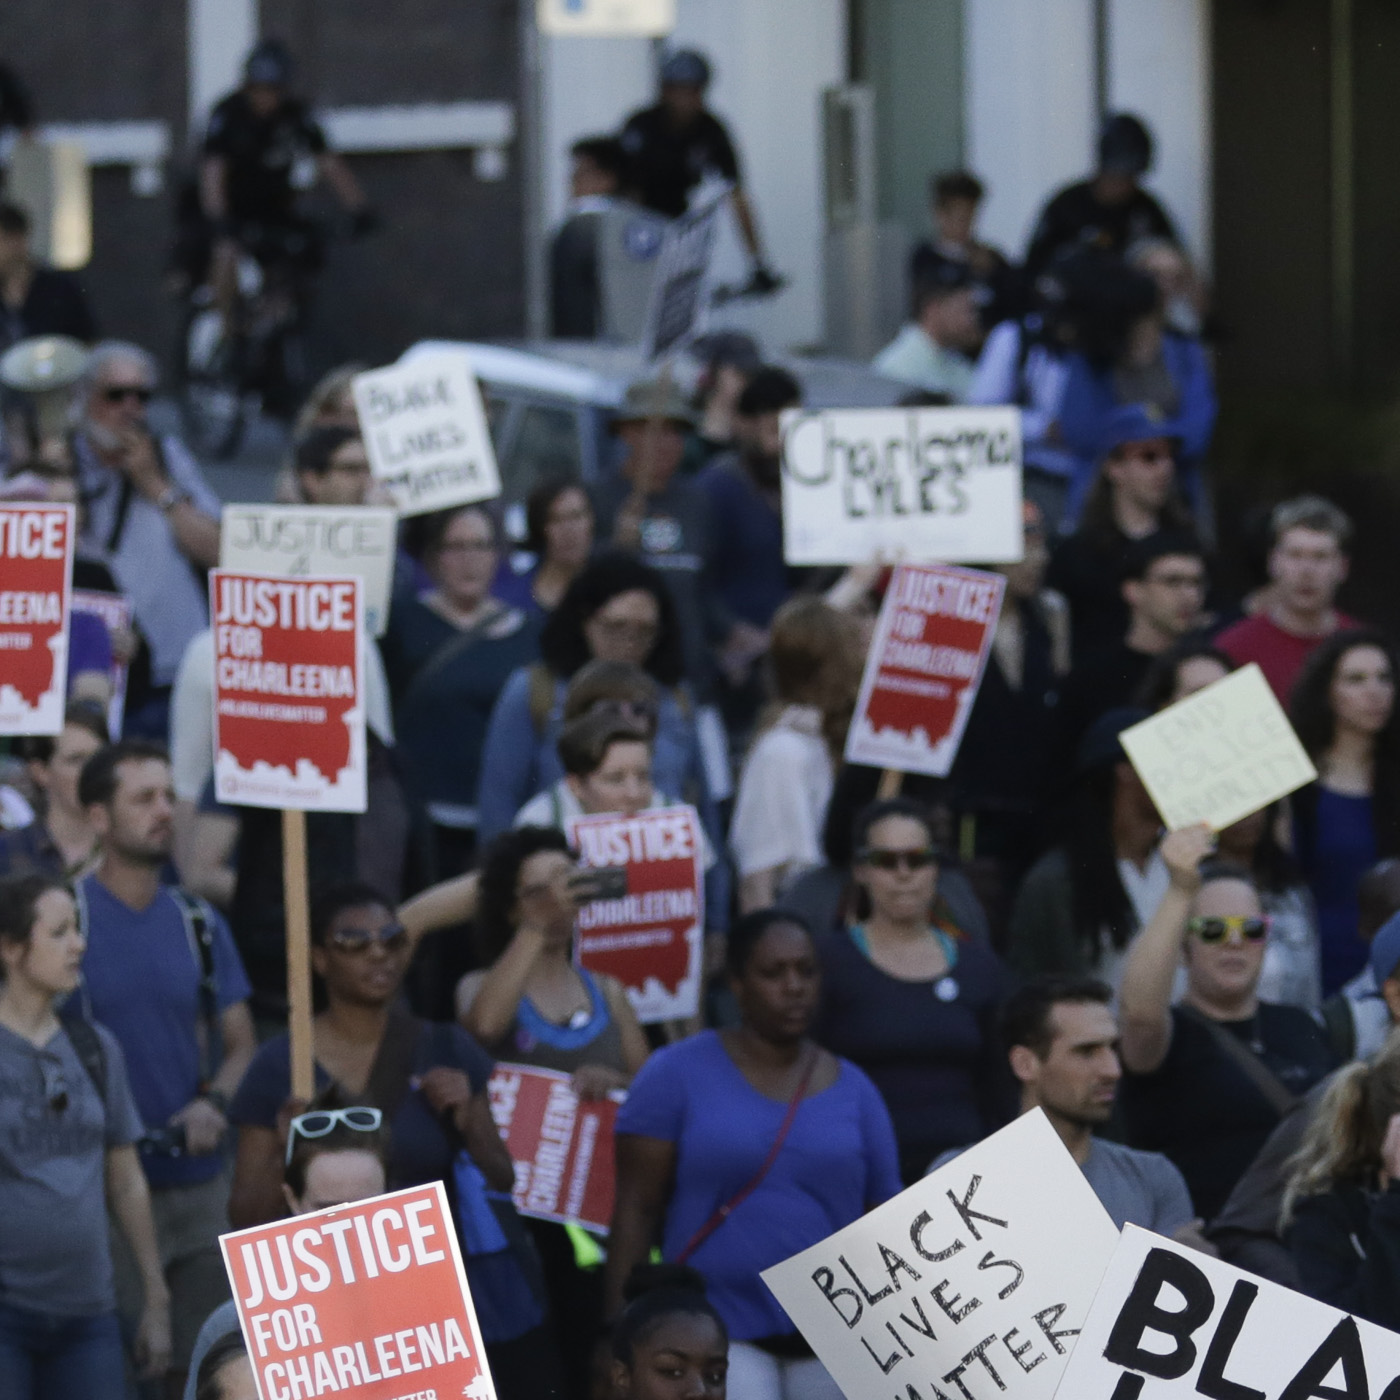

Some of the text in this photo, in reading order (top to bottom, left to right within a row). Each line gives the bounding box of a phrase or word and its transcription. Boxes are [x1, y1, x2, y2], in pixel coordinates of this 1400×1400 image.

[229, 512, 387, 558] JUSTICE
[217, 577, 355, 632] JUSTICE
[900, 566, 995, 623] JUSTICE
[217, 623, 263, 658] FOR
[218, 656, 357, 699] CHARLEENA
[578, 817, 693, 867] JUSTICE
[240, 1197, 446, 1309] JUSTICE
[811, 1173, 1009, 1330] BLACK
[250, 1303, 324, 1358] FOR
[859, 1249, 1025, 1376] LIVES
